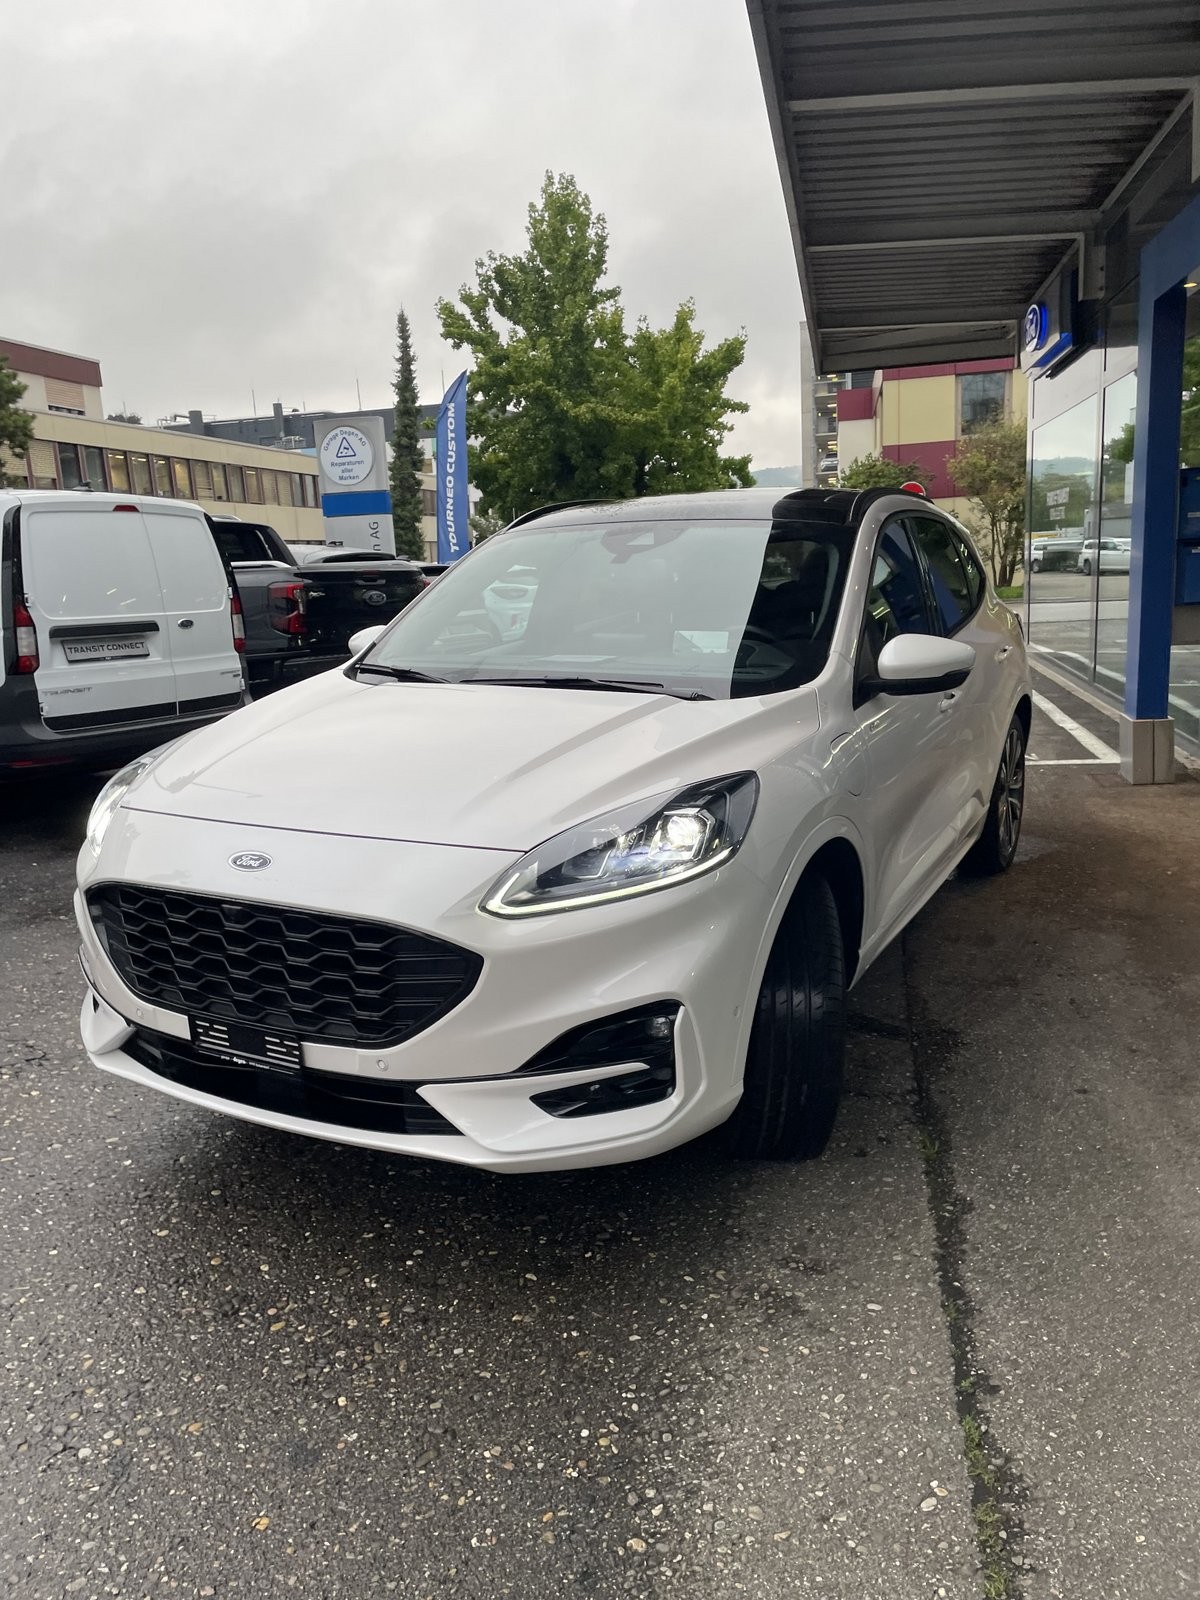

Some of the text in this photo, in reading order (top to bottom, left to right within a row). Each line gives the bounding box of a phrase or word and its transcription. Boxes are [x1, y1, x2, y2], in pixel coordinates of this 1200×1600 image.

[323, 430, 367, 451] Garage Degen AG
[446, 402, 459, 552] TOURNEO CUSTOM
[369, 521, 380, 539] AG
[67, 642, 145, 654] TRANSIT CONNECT
